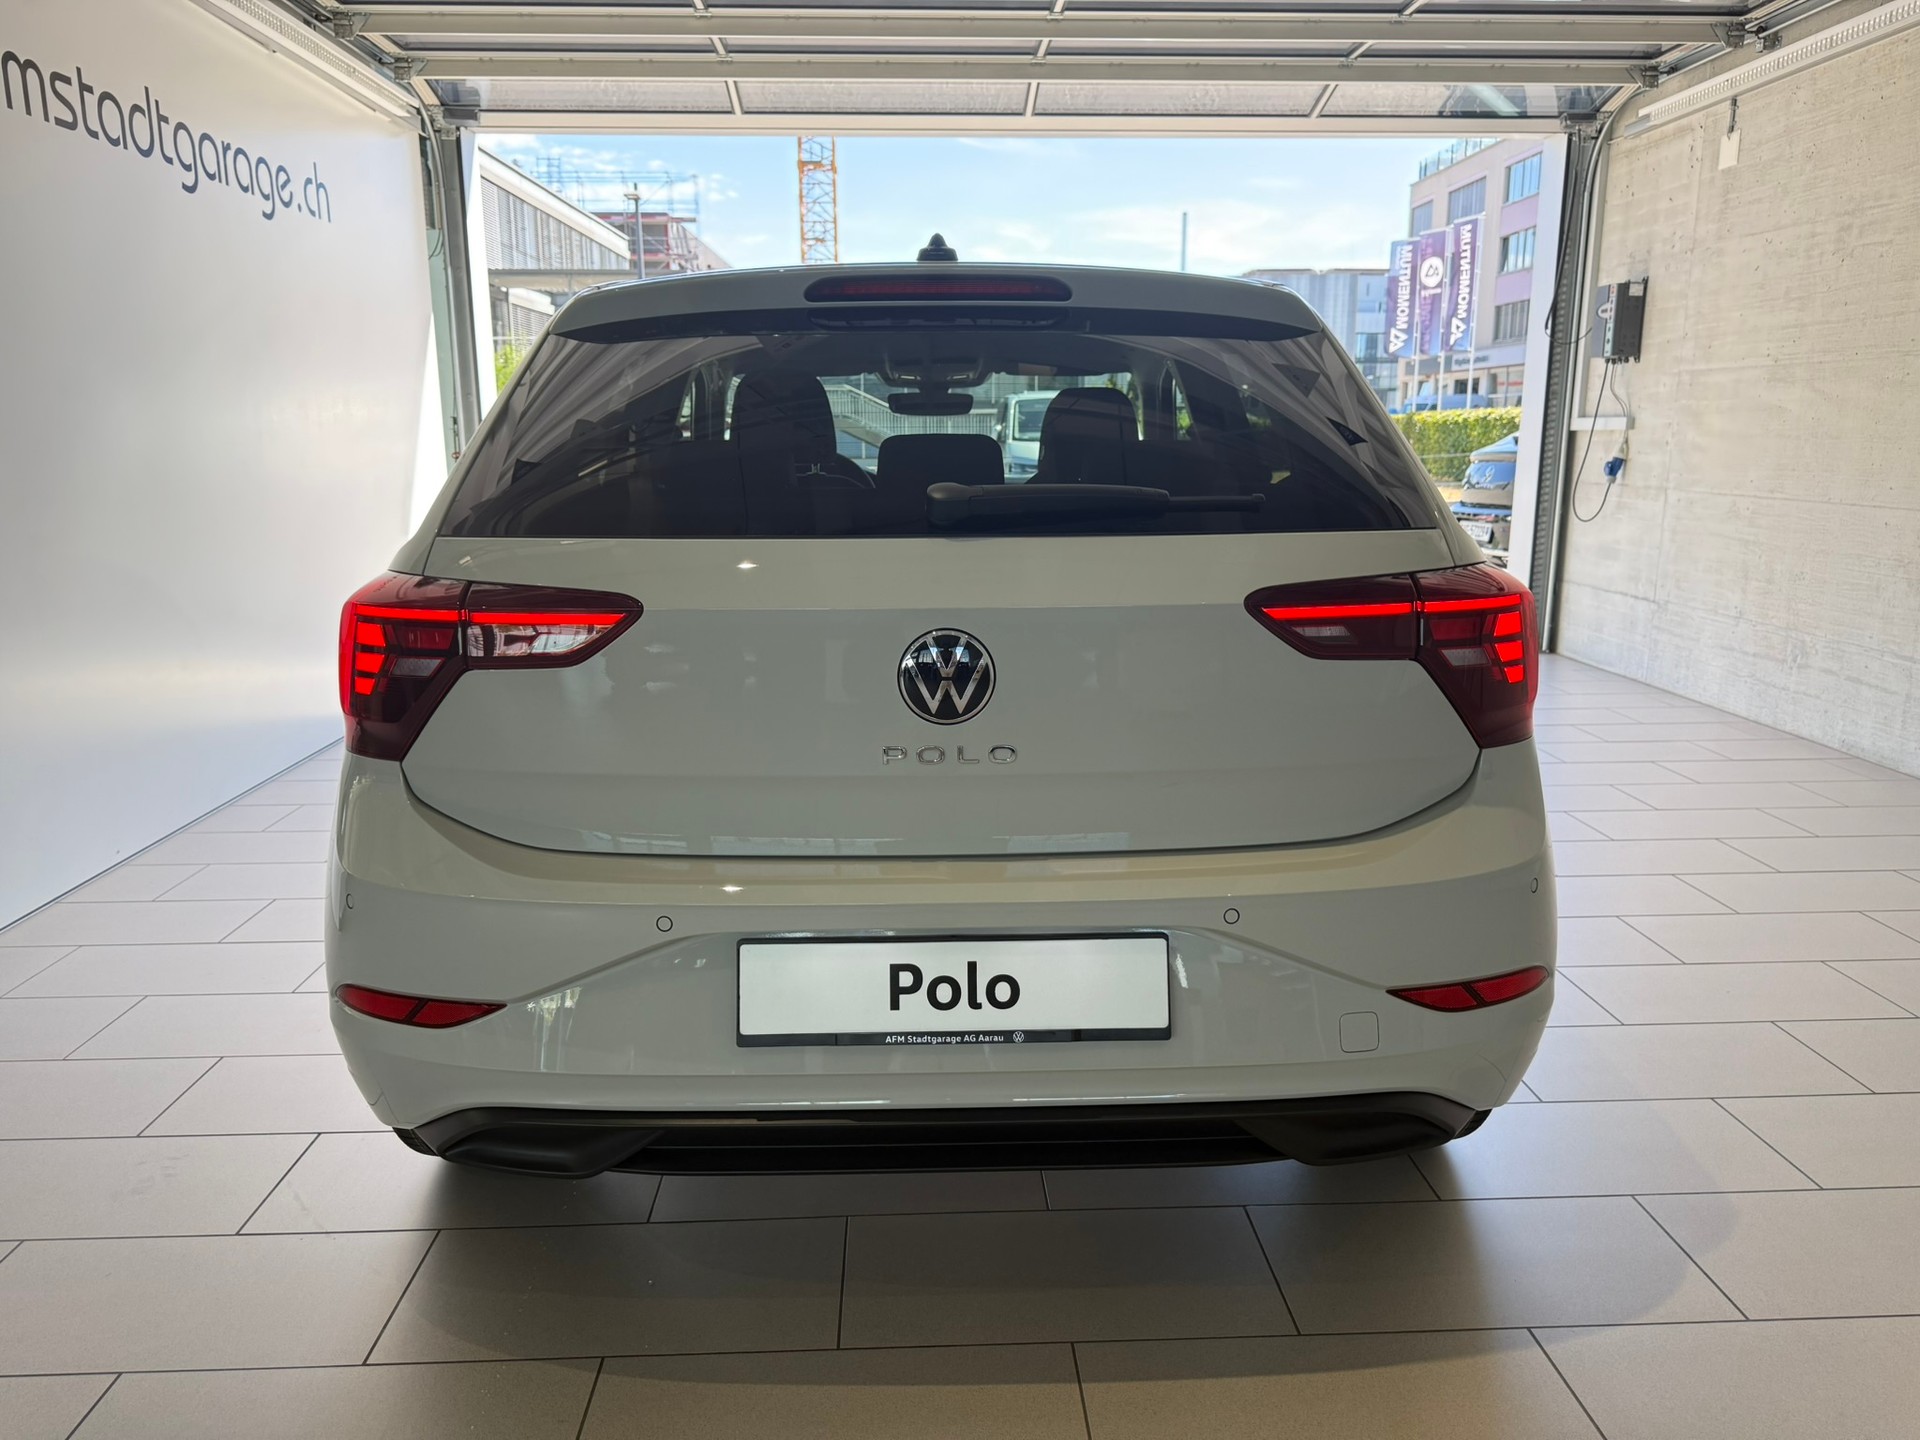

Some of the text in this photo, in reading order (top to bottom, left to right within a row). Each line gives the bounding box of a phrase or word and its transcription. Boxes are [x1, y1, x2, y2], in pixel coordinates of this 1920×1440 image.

[882, 744, 1018, 765] POLO
[889, 961, 1021, 1011] Polo
[885, 1035, 905, 1043] AFM
[907, 1035, 962, 1045] Stadtgarage
[963, 1034, 976, 1042] AG
[978, 1034, 1004, 1042] Aarau
